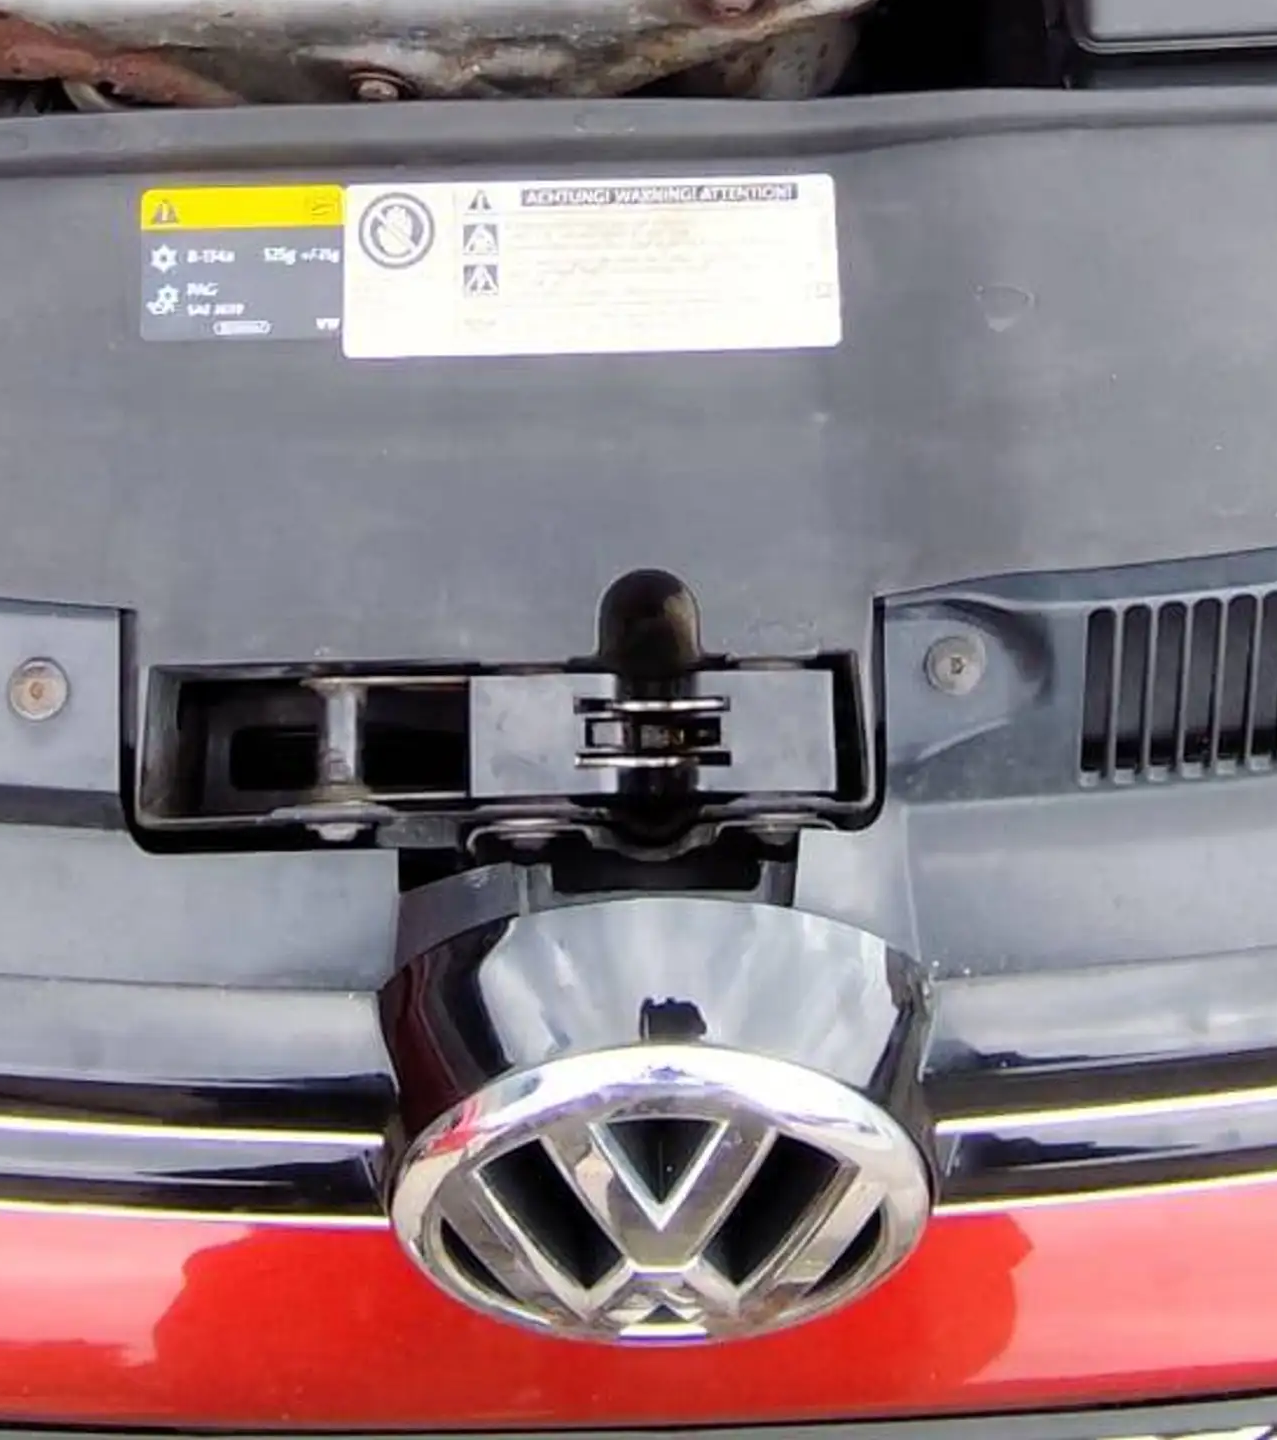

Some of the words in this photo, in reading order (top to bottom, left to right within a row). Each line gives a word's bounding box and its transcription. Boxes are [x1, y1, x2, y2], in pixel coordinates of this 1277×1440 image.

[524, 188, 612, 205] ACHTUNG!
[615, 186, 697, 204] WARNING!
[402, 1060, 919, 1344] VW
